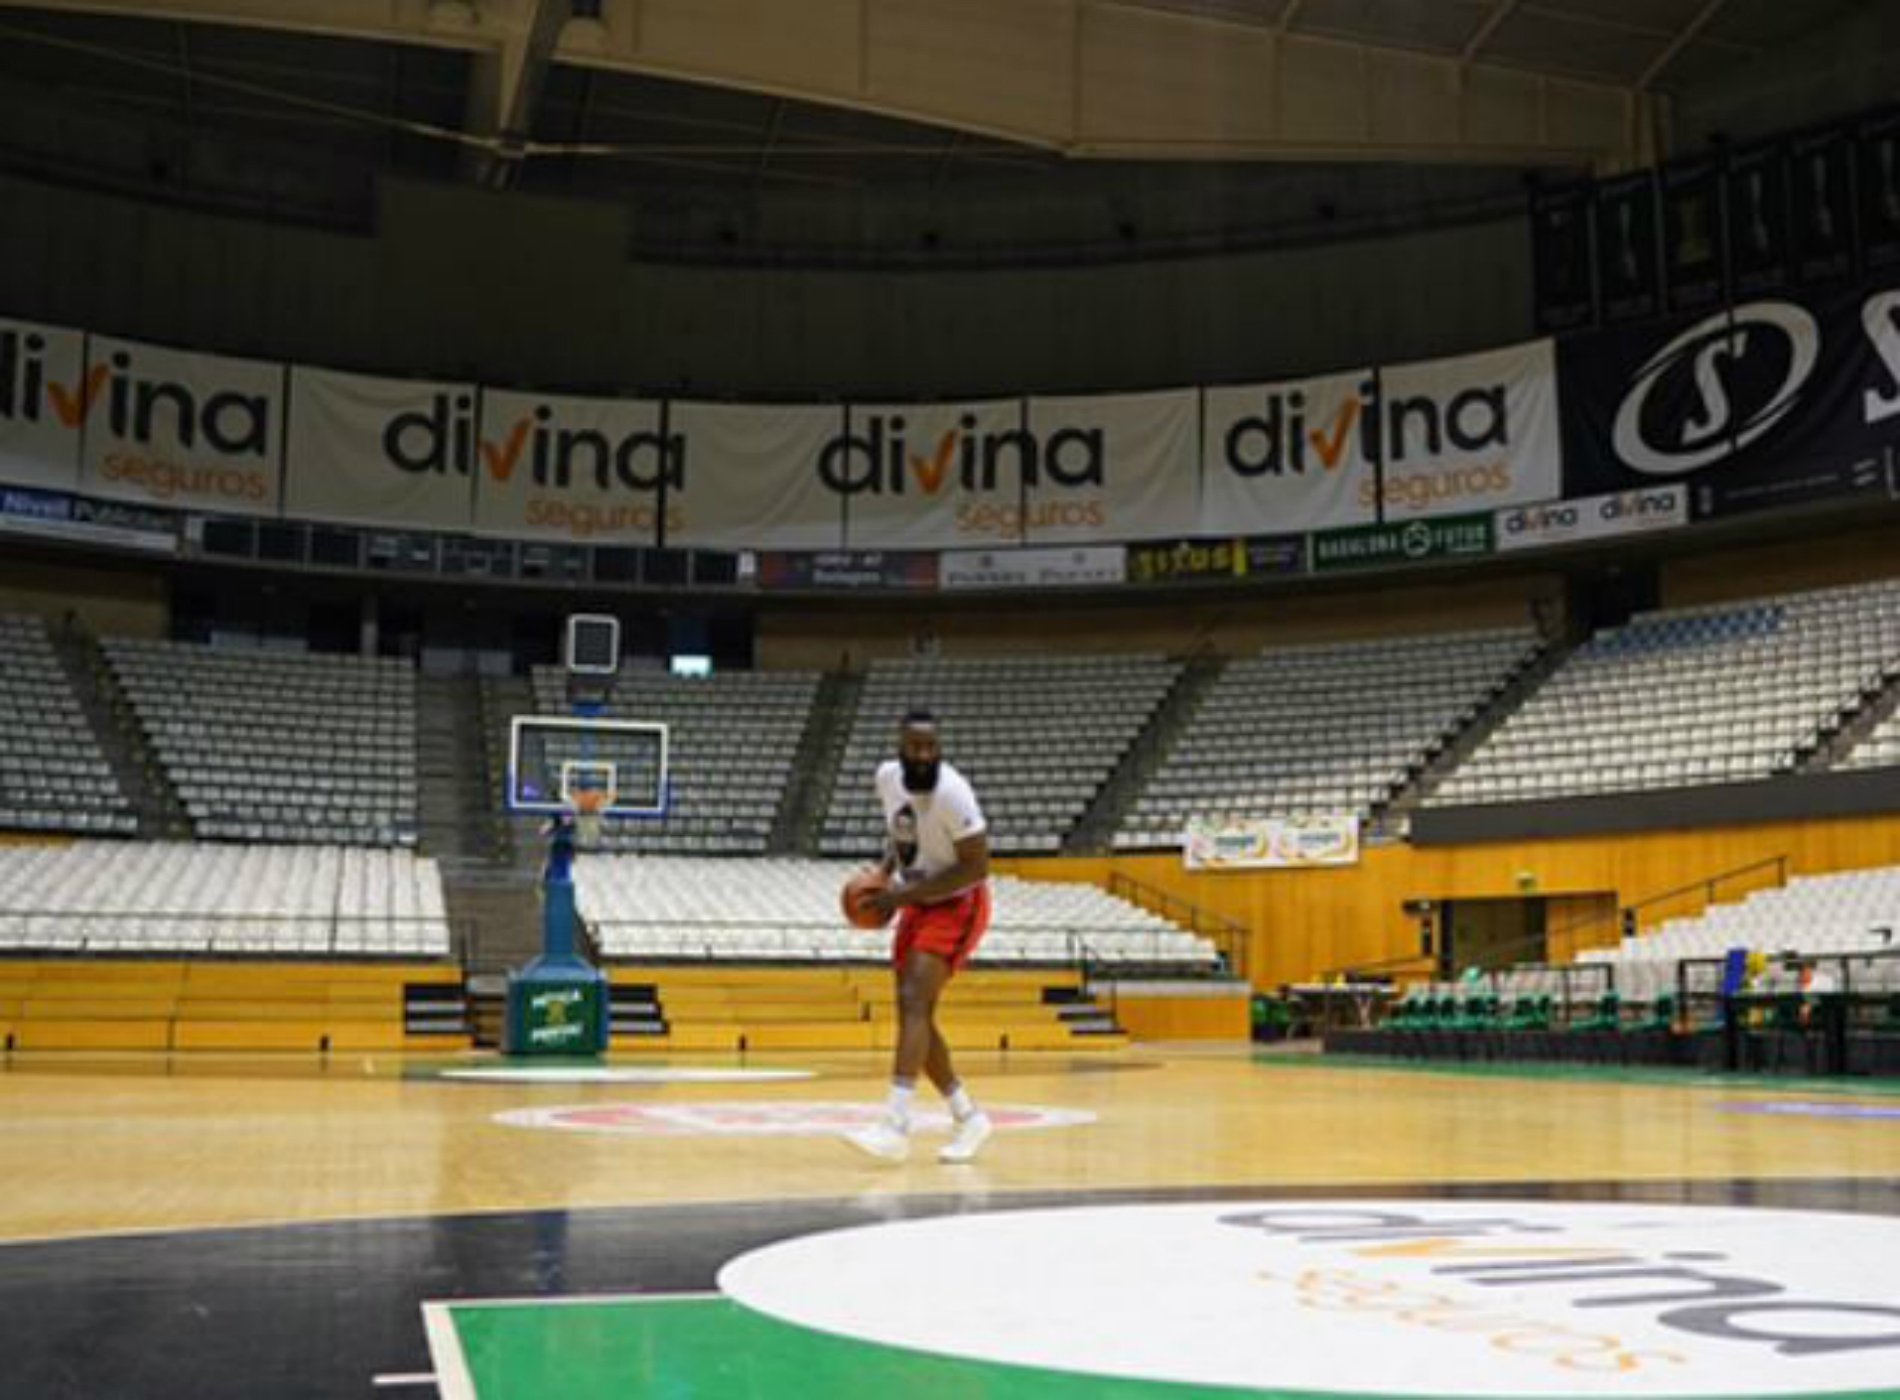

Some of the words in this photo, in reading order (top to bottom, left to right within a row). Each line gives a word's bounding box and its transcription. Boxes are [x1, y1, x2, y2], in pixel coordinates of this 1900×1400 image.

[382, 395, 687, 491] divina
[817, 412, 1105, 495] divina
[1225, 380, 1508, 477] divina
[103, 449, 268, 499] seguros
[1358, 461, 1512, 510] seguros
[525, 499, 687, 535] seguros
[955, 498, 1110, 541] seguros
